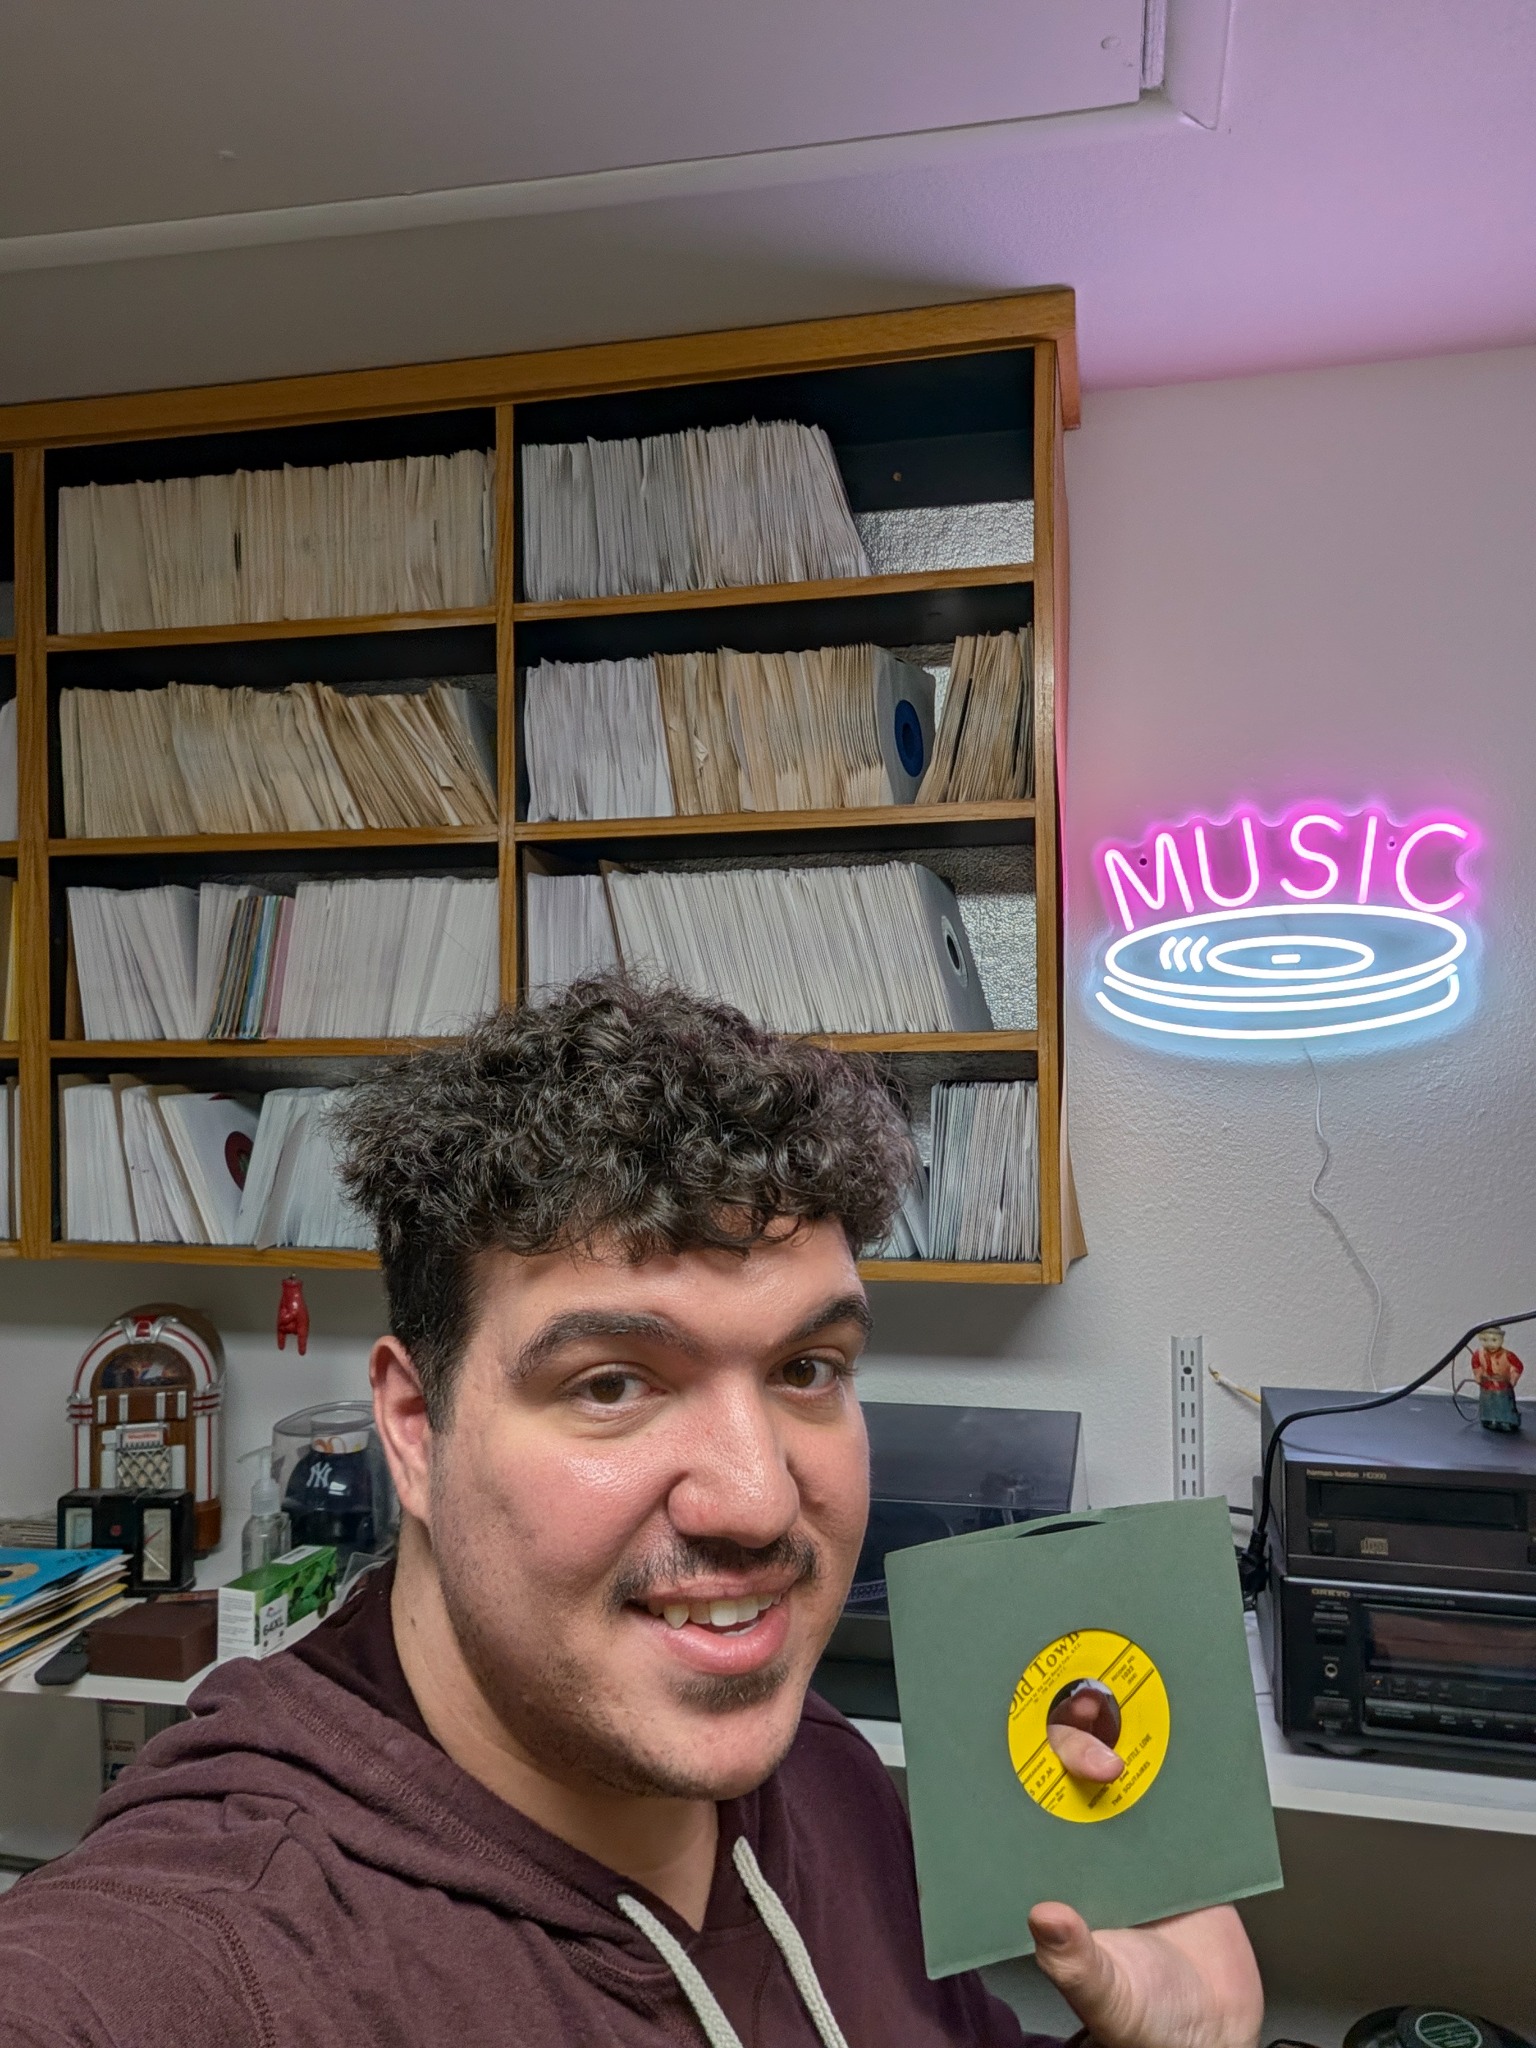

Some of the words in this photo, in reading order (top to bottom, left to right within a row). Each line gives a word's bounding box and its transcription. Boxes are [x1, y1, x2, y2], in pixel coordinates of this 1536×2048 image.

[1104, 814, 1468, 931] MUSIC
[1311, 1588, 1351, 1598] ONKYO
[1029, 1630, 1080, 1679] Town
[1139, 1733, 1153, 1749] LOVE
[1122, 1760, 1151, 1794] SOLITAIRES
